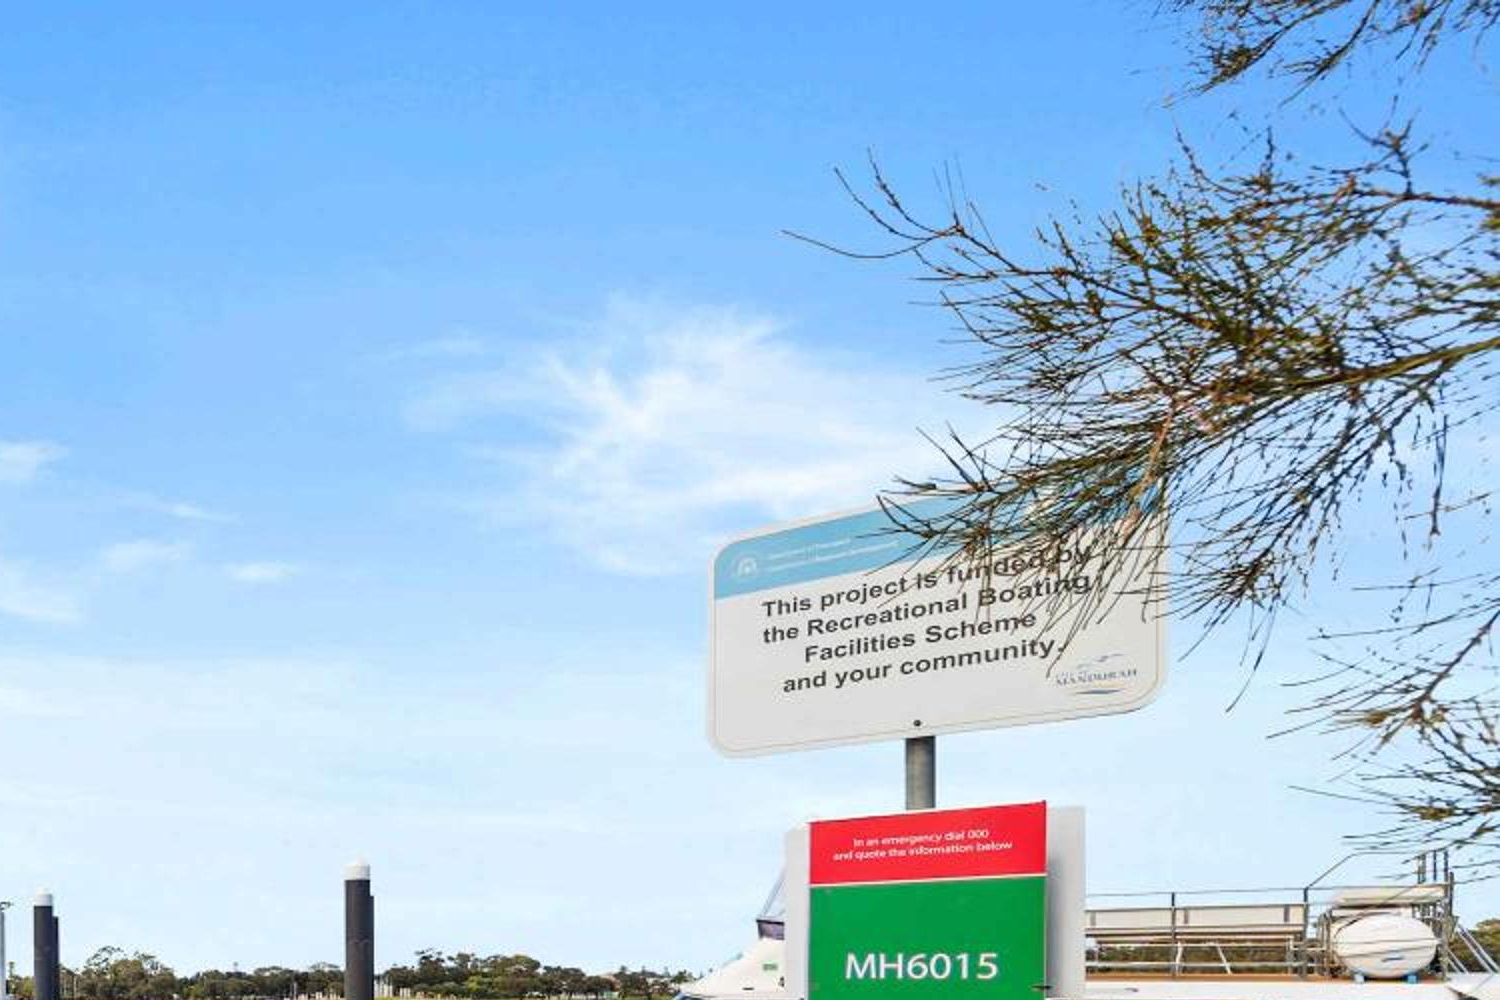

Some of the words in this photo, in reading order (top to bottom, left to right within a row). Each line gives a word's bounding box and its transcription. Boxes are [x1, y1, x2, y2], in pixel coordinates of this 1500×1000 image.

[762, 596, 812, 618] This
[821, 576, 908, 612] project
[917, 572, 938, 590] is
[763, 625, 799, 644] the
[807, 592, 968, 637] Recreational
[979, 575, 1092, 607] Boating
[805, 633, 916, 663] Facilities
[925, 612, 1037, 643] Scheme
[783, 671, 828, 693] and
[835, 664, 893, 689] your
[833, 848, 853, 861] and
[855, 848, 887, 861] quote
[888, 847, 907, 858] the
[908, 842, 974, 857] information
[976, 840, 1013, 852] below
[853, 837, 864, 848] In
[866, 838, 879, 847] an
[881, 833, 942, 847] emergency
[944, 830, 965, 842] dial
[967, 828, 989, 839] 000
[845, 952, 999, 980] MH6015
